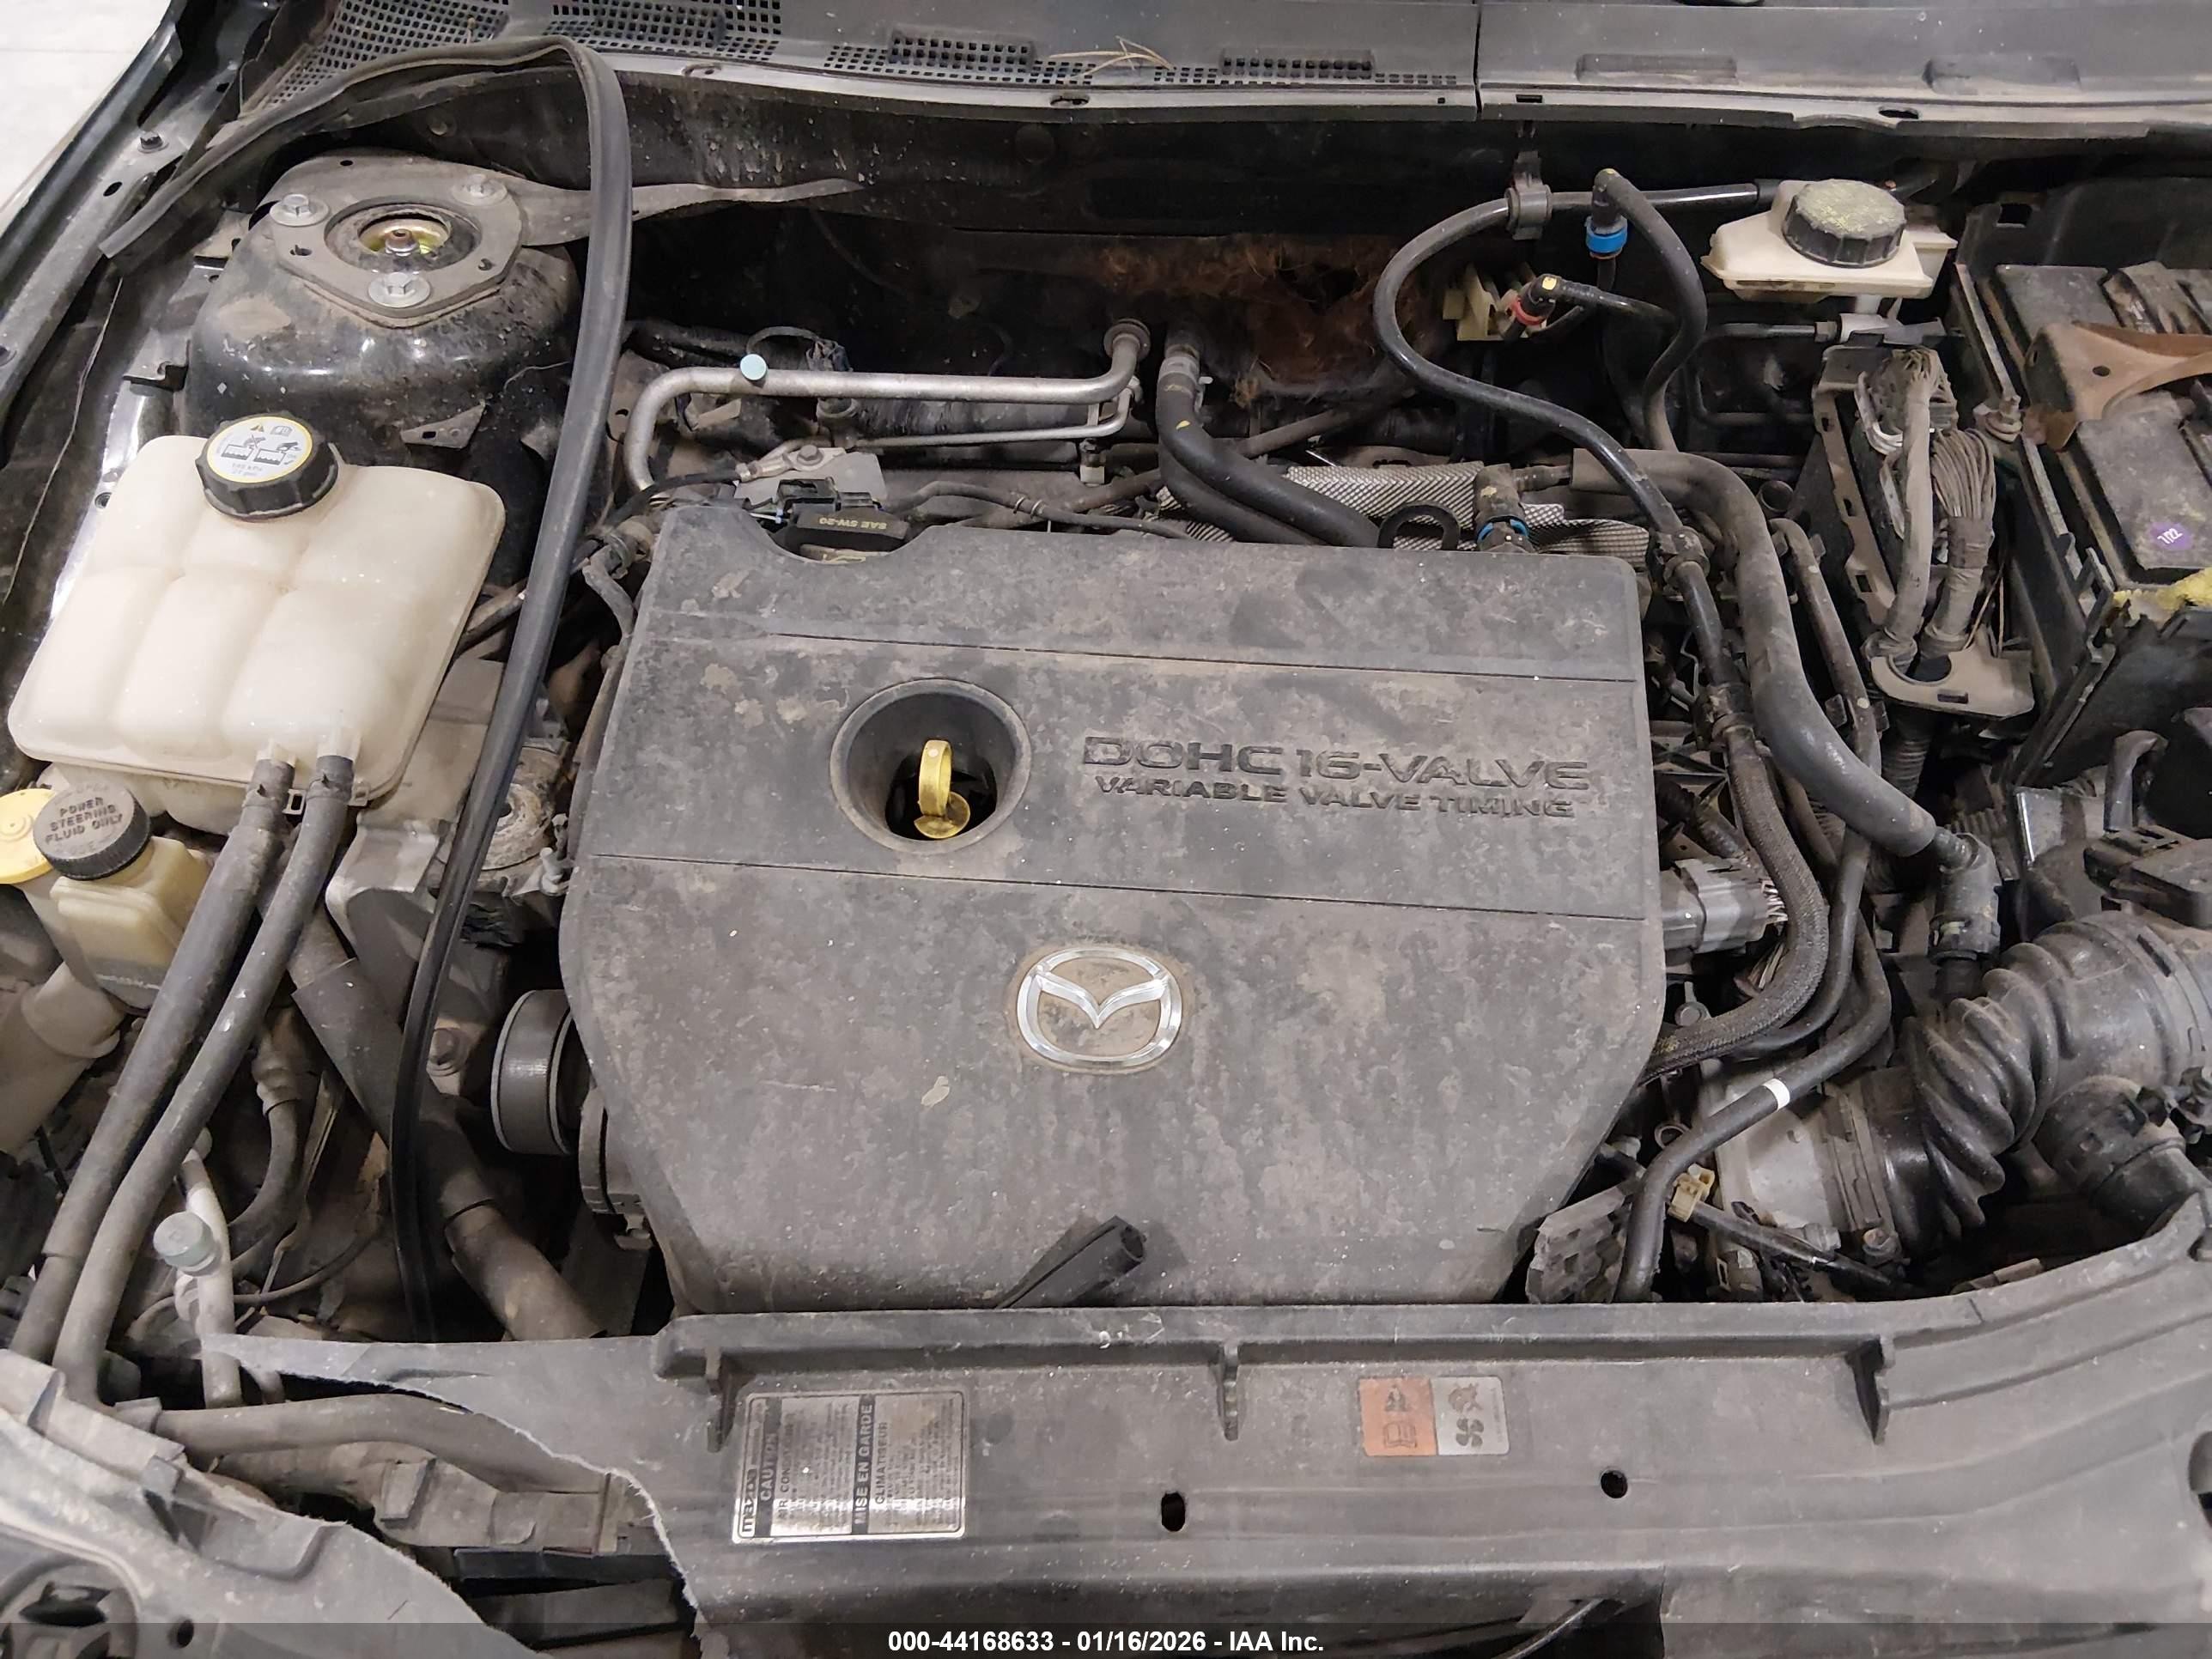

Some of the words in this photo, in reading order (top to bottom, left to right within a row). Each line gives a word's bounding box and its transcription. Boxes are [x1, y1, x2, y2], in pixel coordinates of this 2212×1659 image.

[819, 517, 859, 527] 5W-20
[860, 520, 887, 531] SAE
[1082, 735, 1283, 775] DOHC
[1297, 748, 1590, 791] 16-VALVE
[59, 797, 104, 817] POWER
[1094, 775, 1287, 804] VARIABLE
[1298, 786, 1422, 811] VALVE
[1428, 793, 1576, 819] TIMING
[45, 825, 86, 846] FLUID
[91, 813, 124, 830] ONLY
[49, 805, 117, 832] STEERING
[858, 1404, 873, 1457] GARDE
[759, 1432, 777, 1502] CAUTION
[856, 1462, 870, 1483] EN
[875, 1422, 888, 1505] CLIMATISEUR
[854, 1486, 868, 1525] MISE
